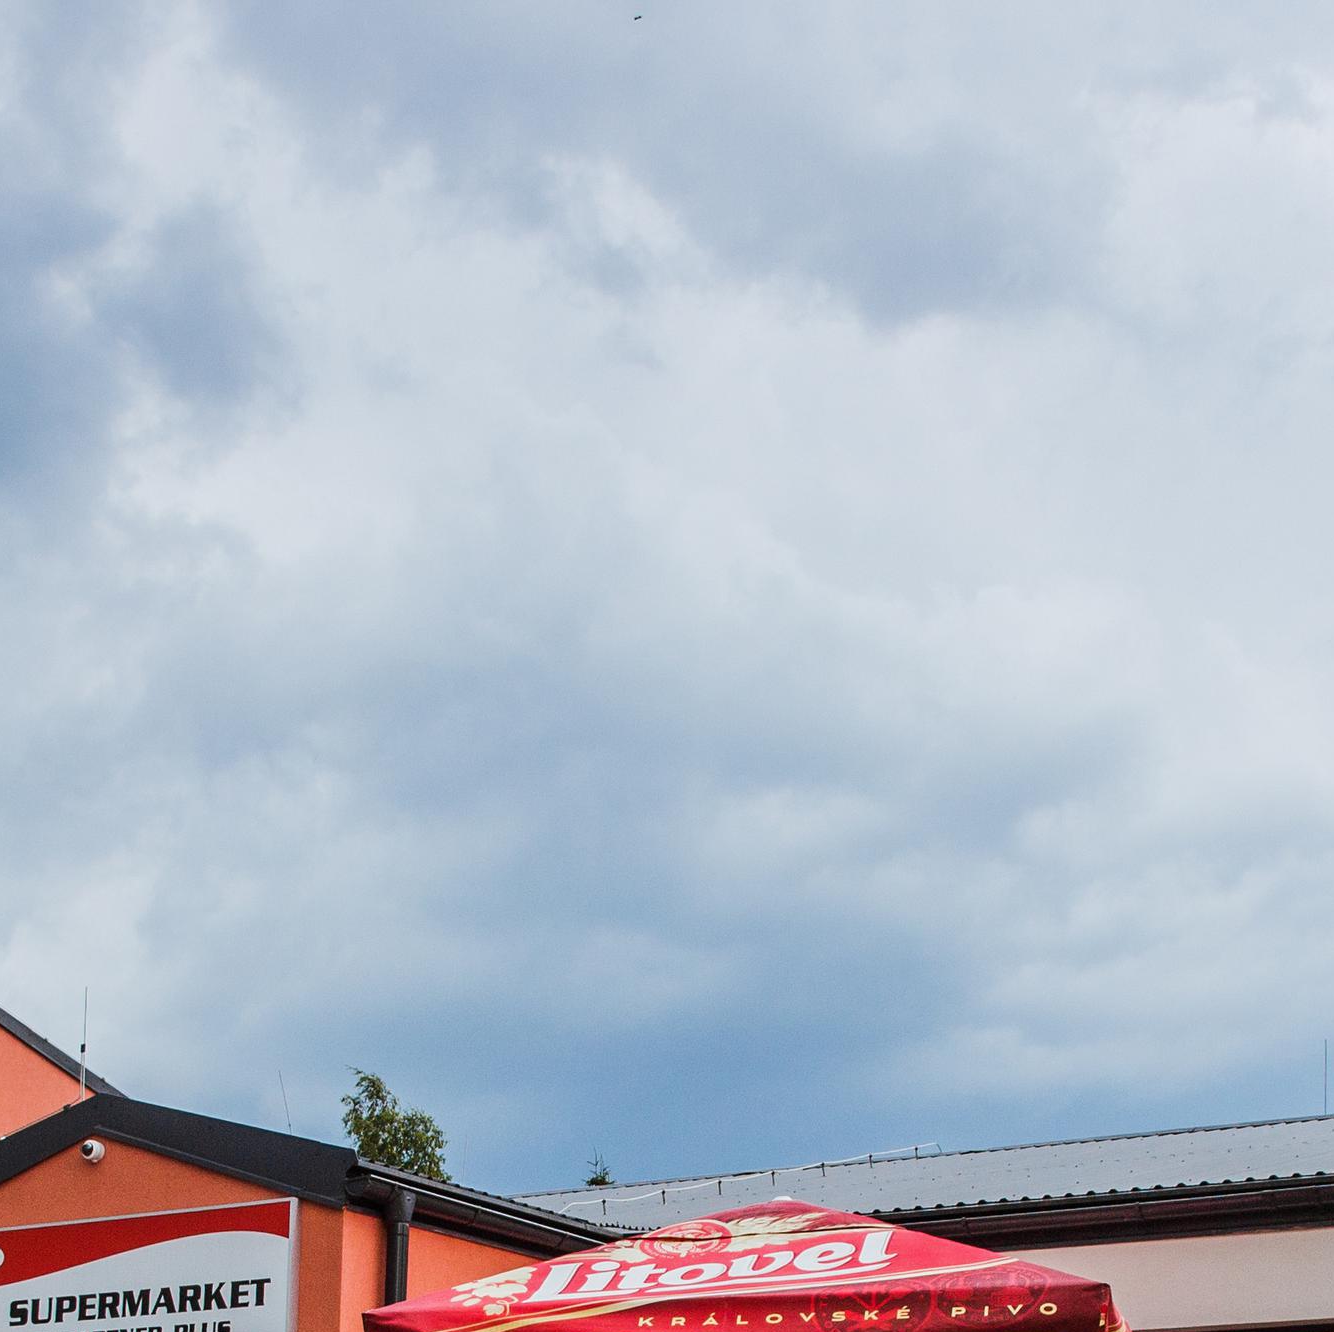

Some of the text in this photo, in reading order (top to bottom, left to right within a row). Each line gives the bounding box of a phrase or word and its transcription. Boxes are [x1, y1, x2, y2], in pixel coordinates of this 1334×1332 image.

[523, 1230, 899, 1304] Litovel
[9, 1278, 271, 1326] SUPERMARKET
[638, 1302, 1058, 1328] KRÁLOVSKÉ PIVO
